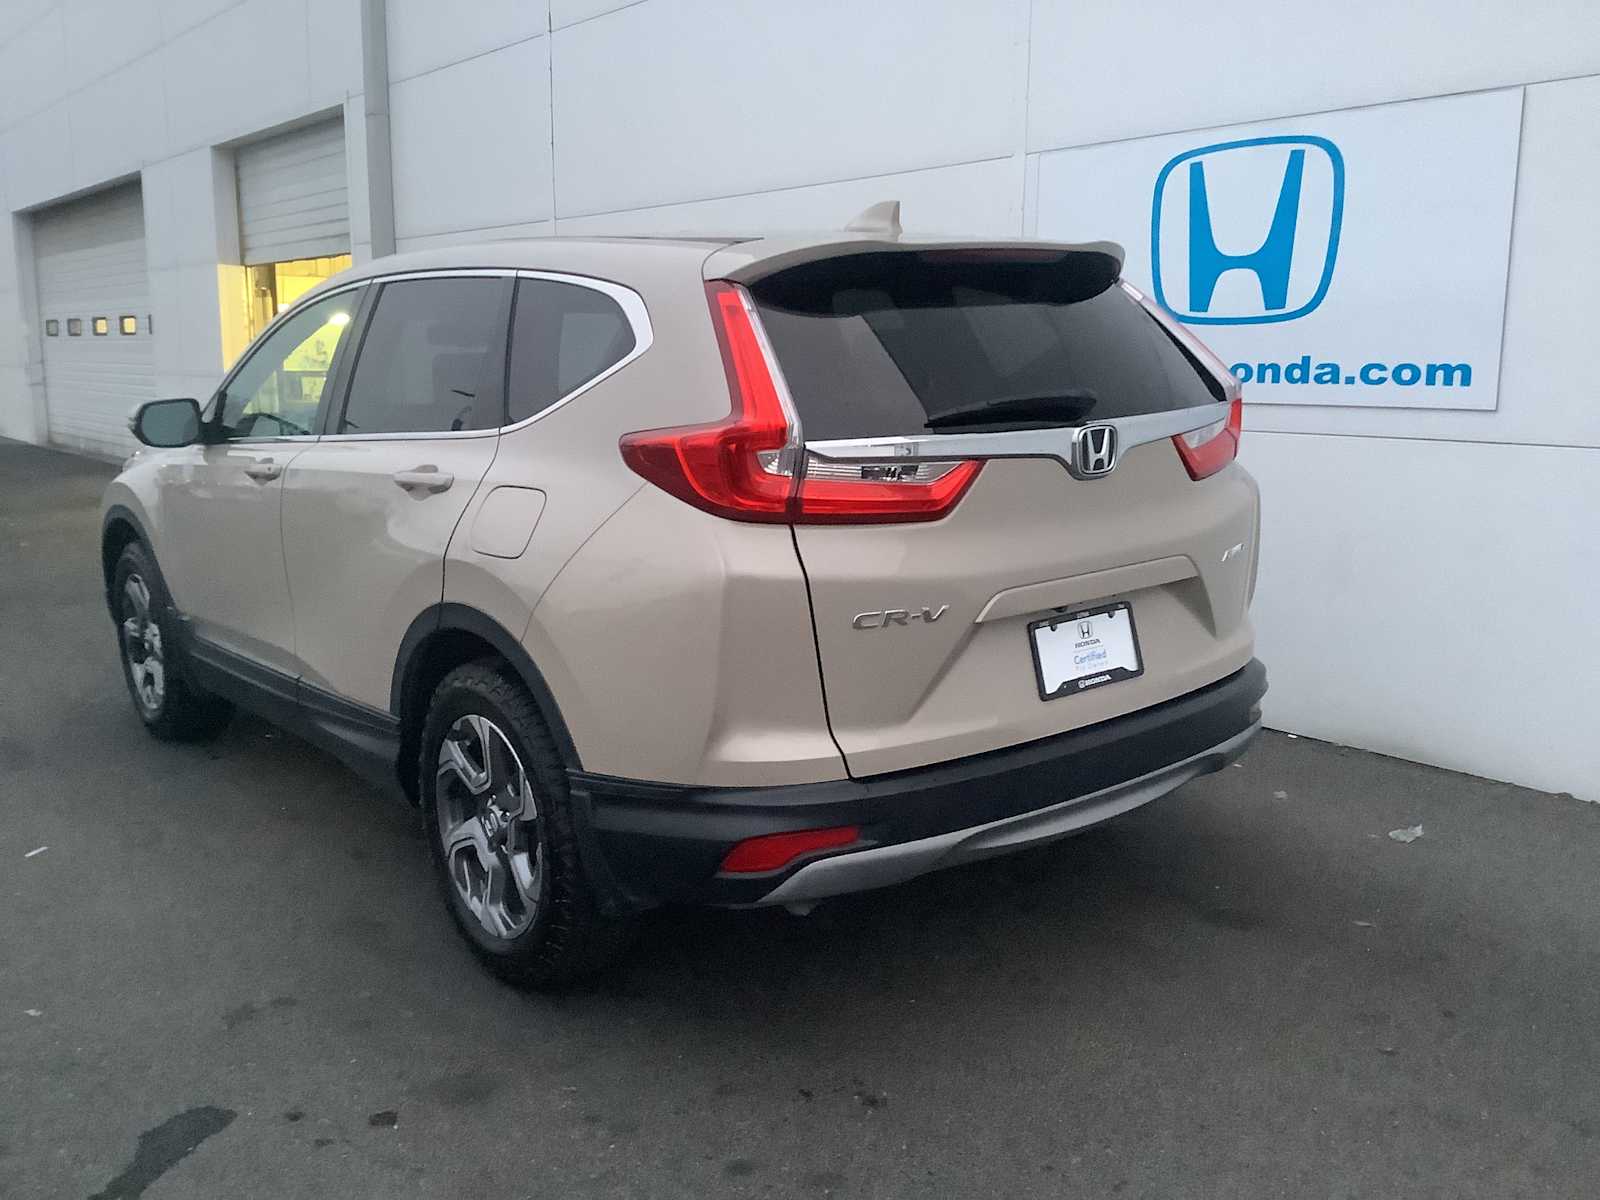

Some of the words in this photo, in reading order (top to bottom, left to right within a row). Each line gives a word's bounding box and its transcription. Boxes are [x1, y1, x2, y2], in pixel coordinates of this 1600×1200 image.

[853, 605, 950, 629] CR-V
[1074, 638, 1101, 649] HONDA
[1073, 649, 1107, 665] Certified
